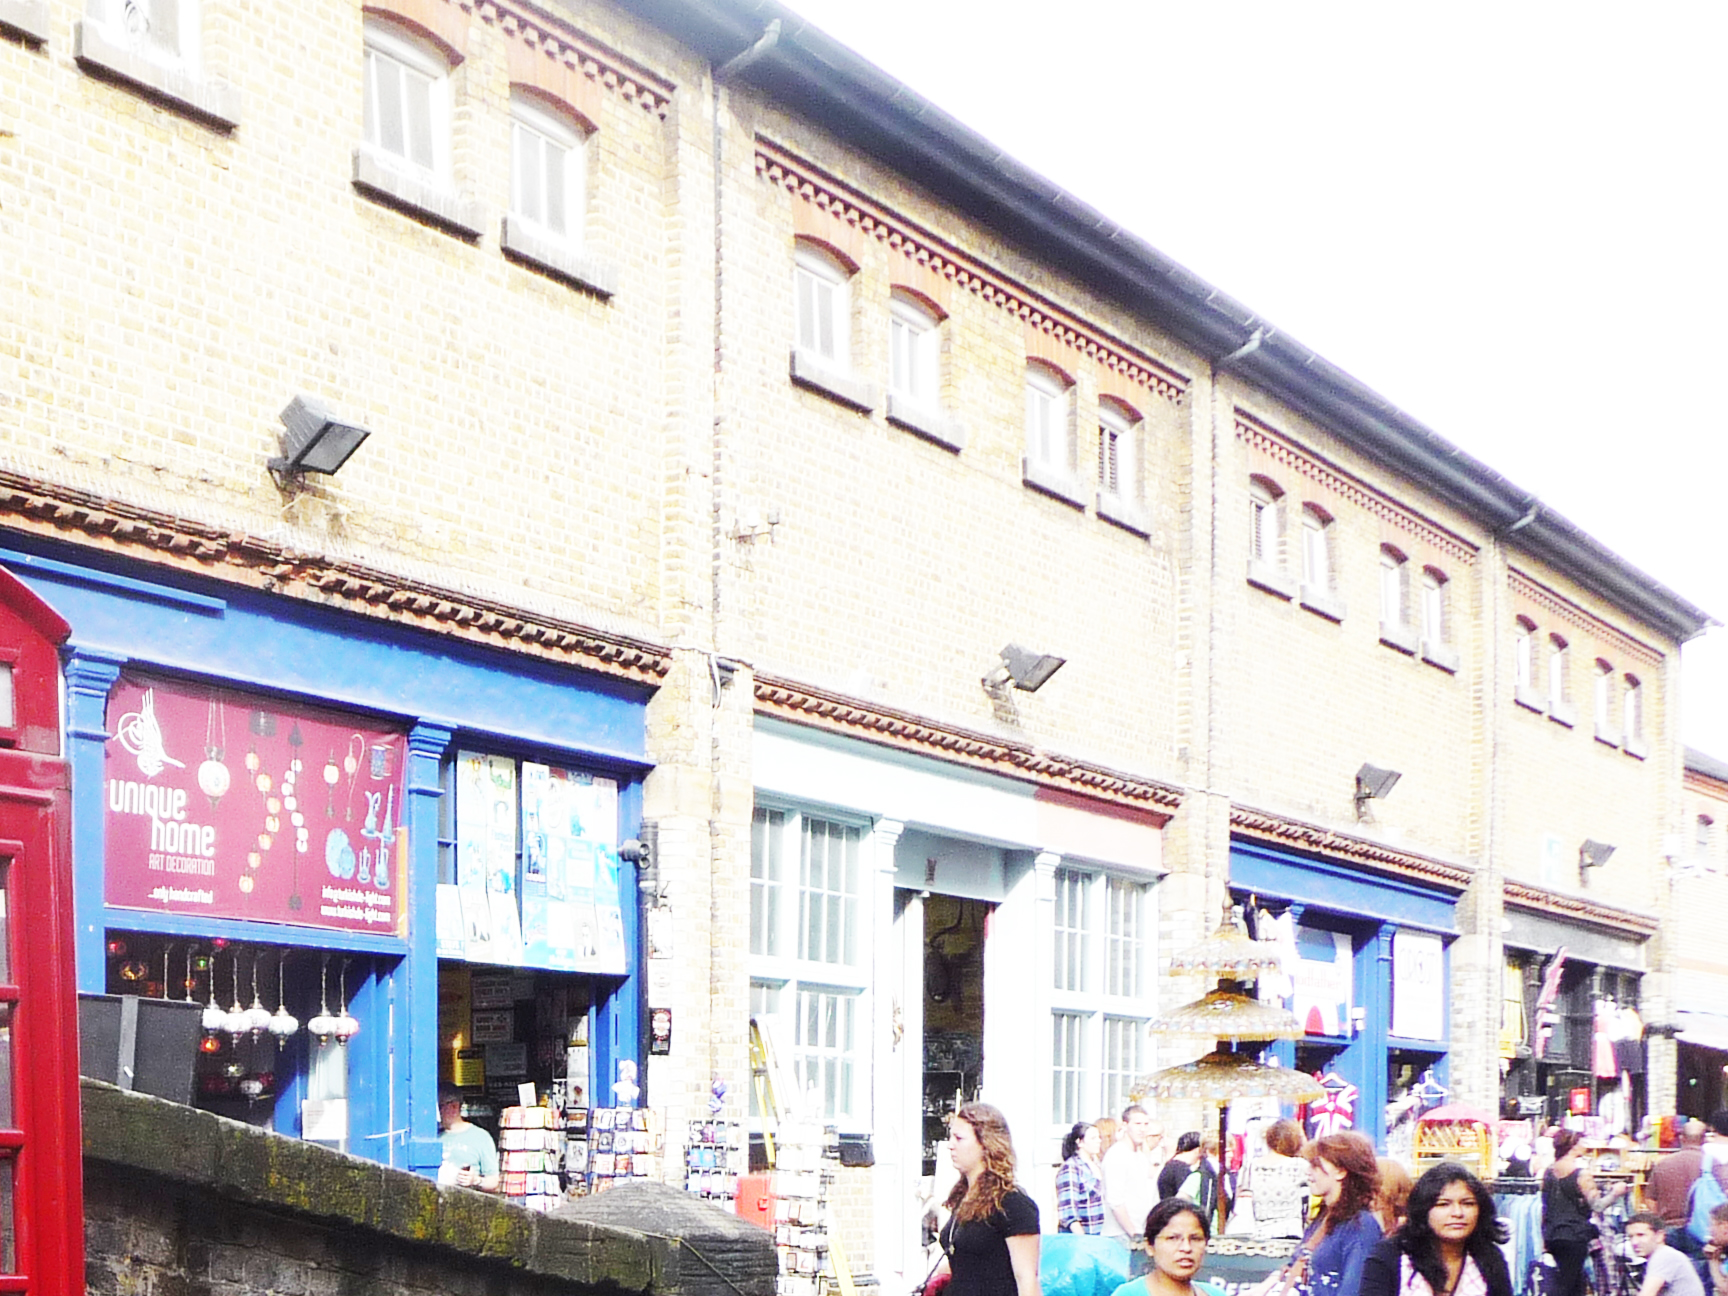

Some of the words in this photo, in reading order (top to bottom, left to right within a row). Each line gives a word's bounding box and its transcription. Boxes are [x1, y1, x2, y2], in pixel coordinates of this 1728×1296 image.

[109, 778, 187, 822] unique
[150, 815, 215, 857] home
[148, 853, 165, 871] ART
[166, 855, 215, 876] DECORATION
